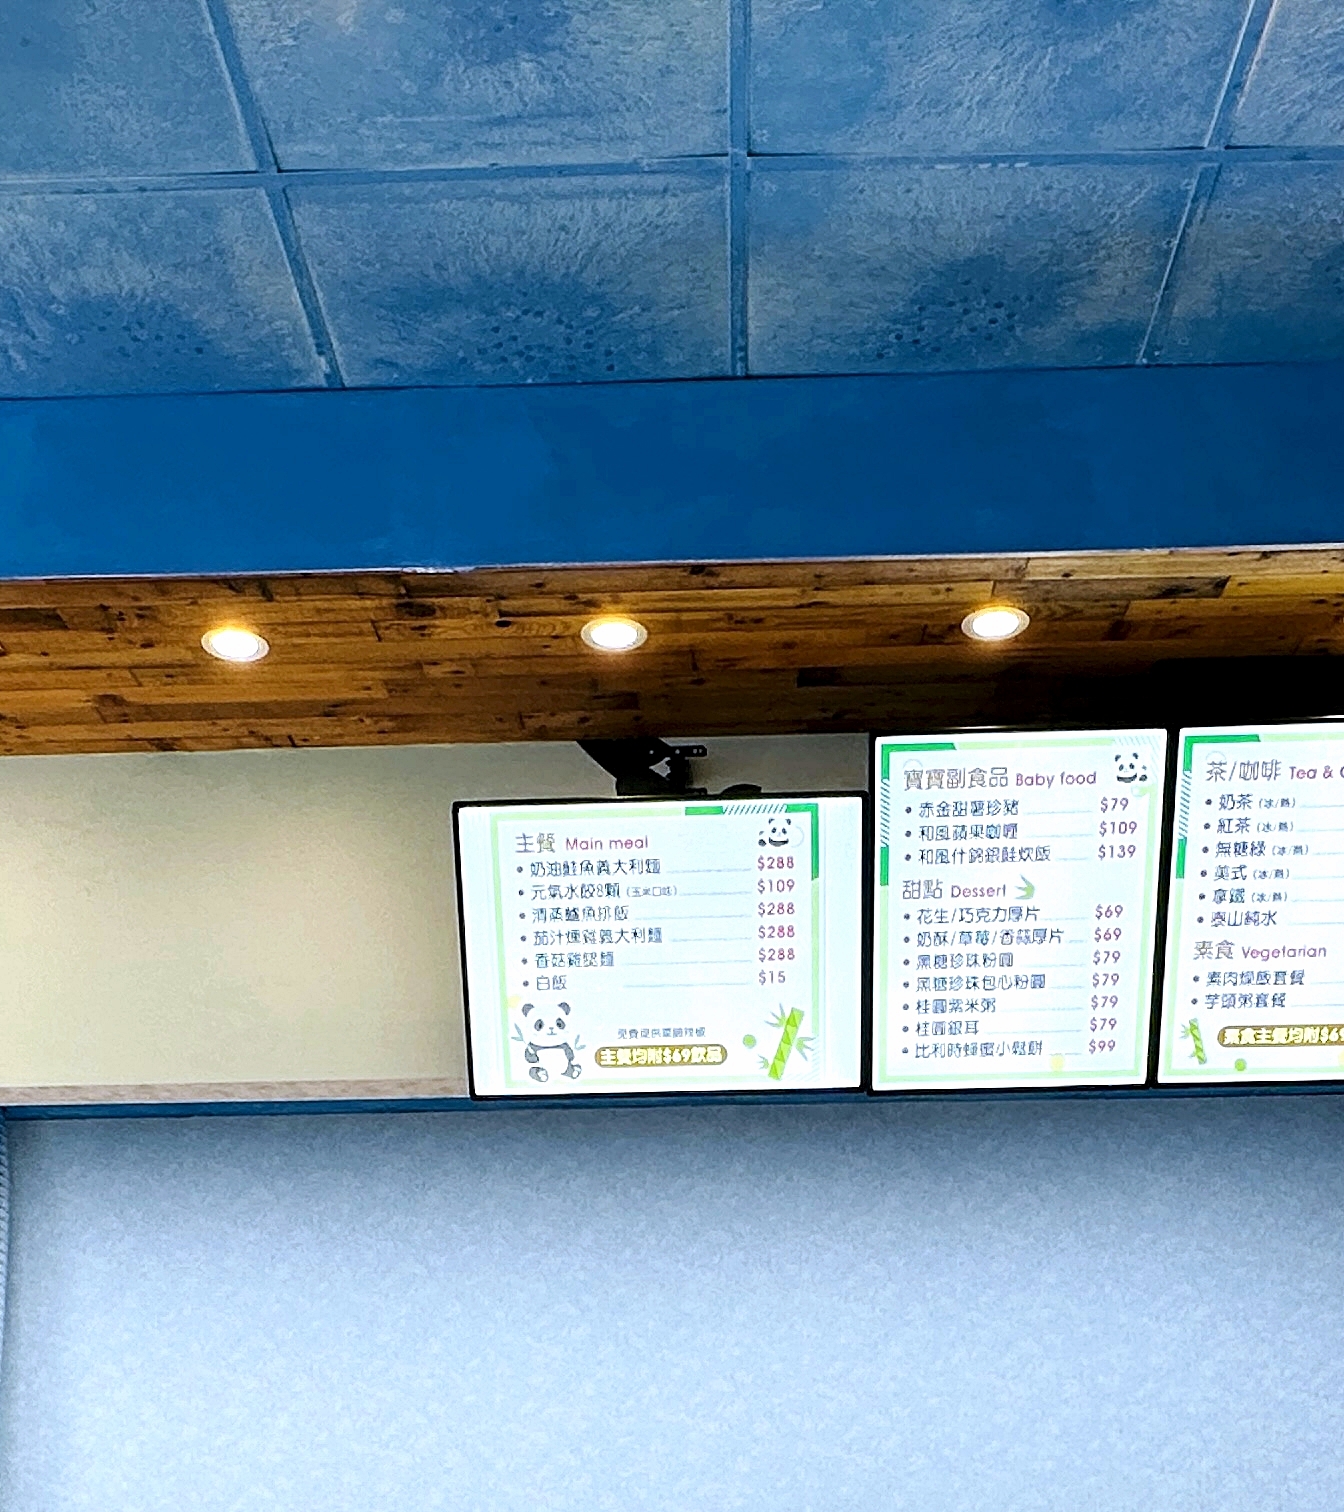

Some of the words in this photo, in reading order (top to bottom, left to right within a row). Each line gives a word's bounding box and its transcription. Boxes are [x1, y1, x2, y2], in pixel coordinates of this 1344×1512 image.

[904, 766, 1008, 791] 寶寶副食品
[1015, 772, 1055, 789] Baby
[1060, 771, 1097, 785] food
[1206, 759, 1282, 782] 茶/咖啡
[1289, 766, 1317, 780] Tea
[1323, 766, 1333, 779] &
[1100, 797, 1129, 813] $79
[1219, 793, 1253, 811] 奶茶
[1099, 820, 1138, 836] $109
[1217, 817, 1251, 834] 紅茶
[515, 832, 556, 853] 主餐
[565, 837, 603, 850] Main
[609, 835, 649, 849] meal
[1097, 844, 1136, 860] $139
[757, 855, 794, 871] $288
[757, 879, 795, 893] $109
[902, 879, 943, 901] 甜點
[951, 884, 1006, 898] Dessert
[757, 902, 795, 917] $288
[1095, 904, 1124, 920] $69
[757, 925, 795, 940] $288
[1094, 927, 1123, 943] $69
[758, 947, 795, 963] $288
[1092, 950, 1121, 965] $79
[1193, 940, 1235, 961] 素食
[1242, 945, 1327, 962] Vegetarian
[758, 970, 785, 986] $15
[1092, 973, 1120, 988] $79
[1091, 995, 1119, 1011] $79
[1089, 1017, 1117, 1034] $79
[1088, 1039, 1116, 1054] $99
